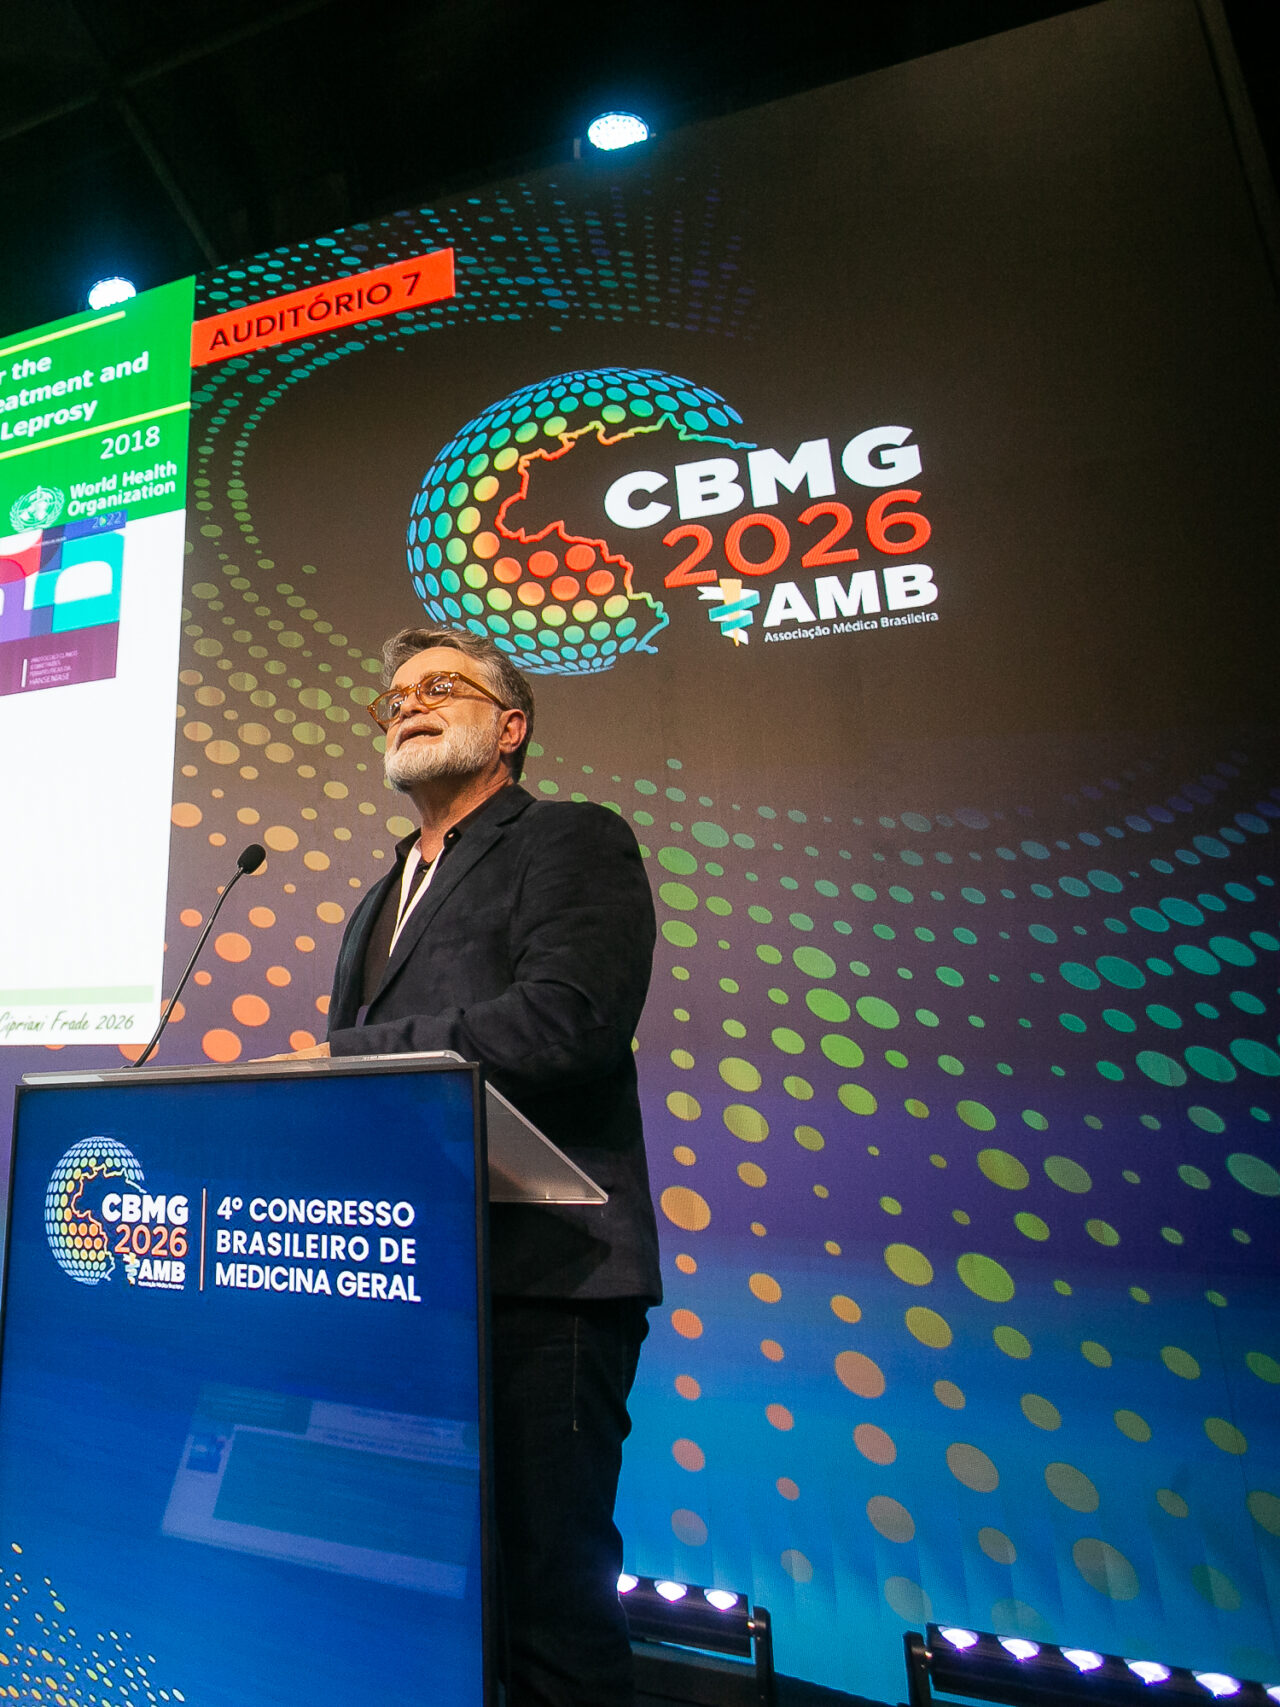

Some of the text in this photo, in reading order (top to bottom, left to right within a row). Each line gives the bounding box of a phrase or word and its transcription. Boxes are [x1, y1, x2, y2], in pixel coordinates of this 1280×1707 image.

[209, 271, 421, 351] AUDITÓRIO 7
[11, 356, 52, 381] the
[99, 350, 149, 383] and
[0, 400, 98, 441] Leprosy
[100, 425, 160, 460] 2018
[70, 460, 177, 501] World Health
[603, 425, 922, 529] CBMG
[67, 480, 176, 518] Organization
[661, 489, 932, 589] 2026
[762, 563, 939, 628] AMB
[764, 611, 939, 643] Associação Médica Brasileira
[50, 1010, 90, 1031] Frade
[95, 1014, 135, 1031] 2026
[101, 1193, 189, 1226] CBMG
[216, 1196, 416, 1228] 4º CONGRESSO
[114, 1224, 188, 1258] 2026
[216, 1229, 417, 1264] BRASILEIRO DE
[138, 1258, 186, 1283] AMB
[215, 1262, 422, 1303] MEDICINA GERAL
